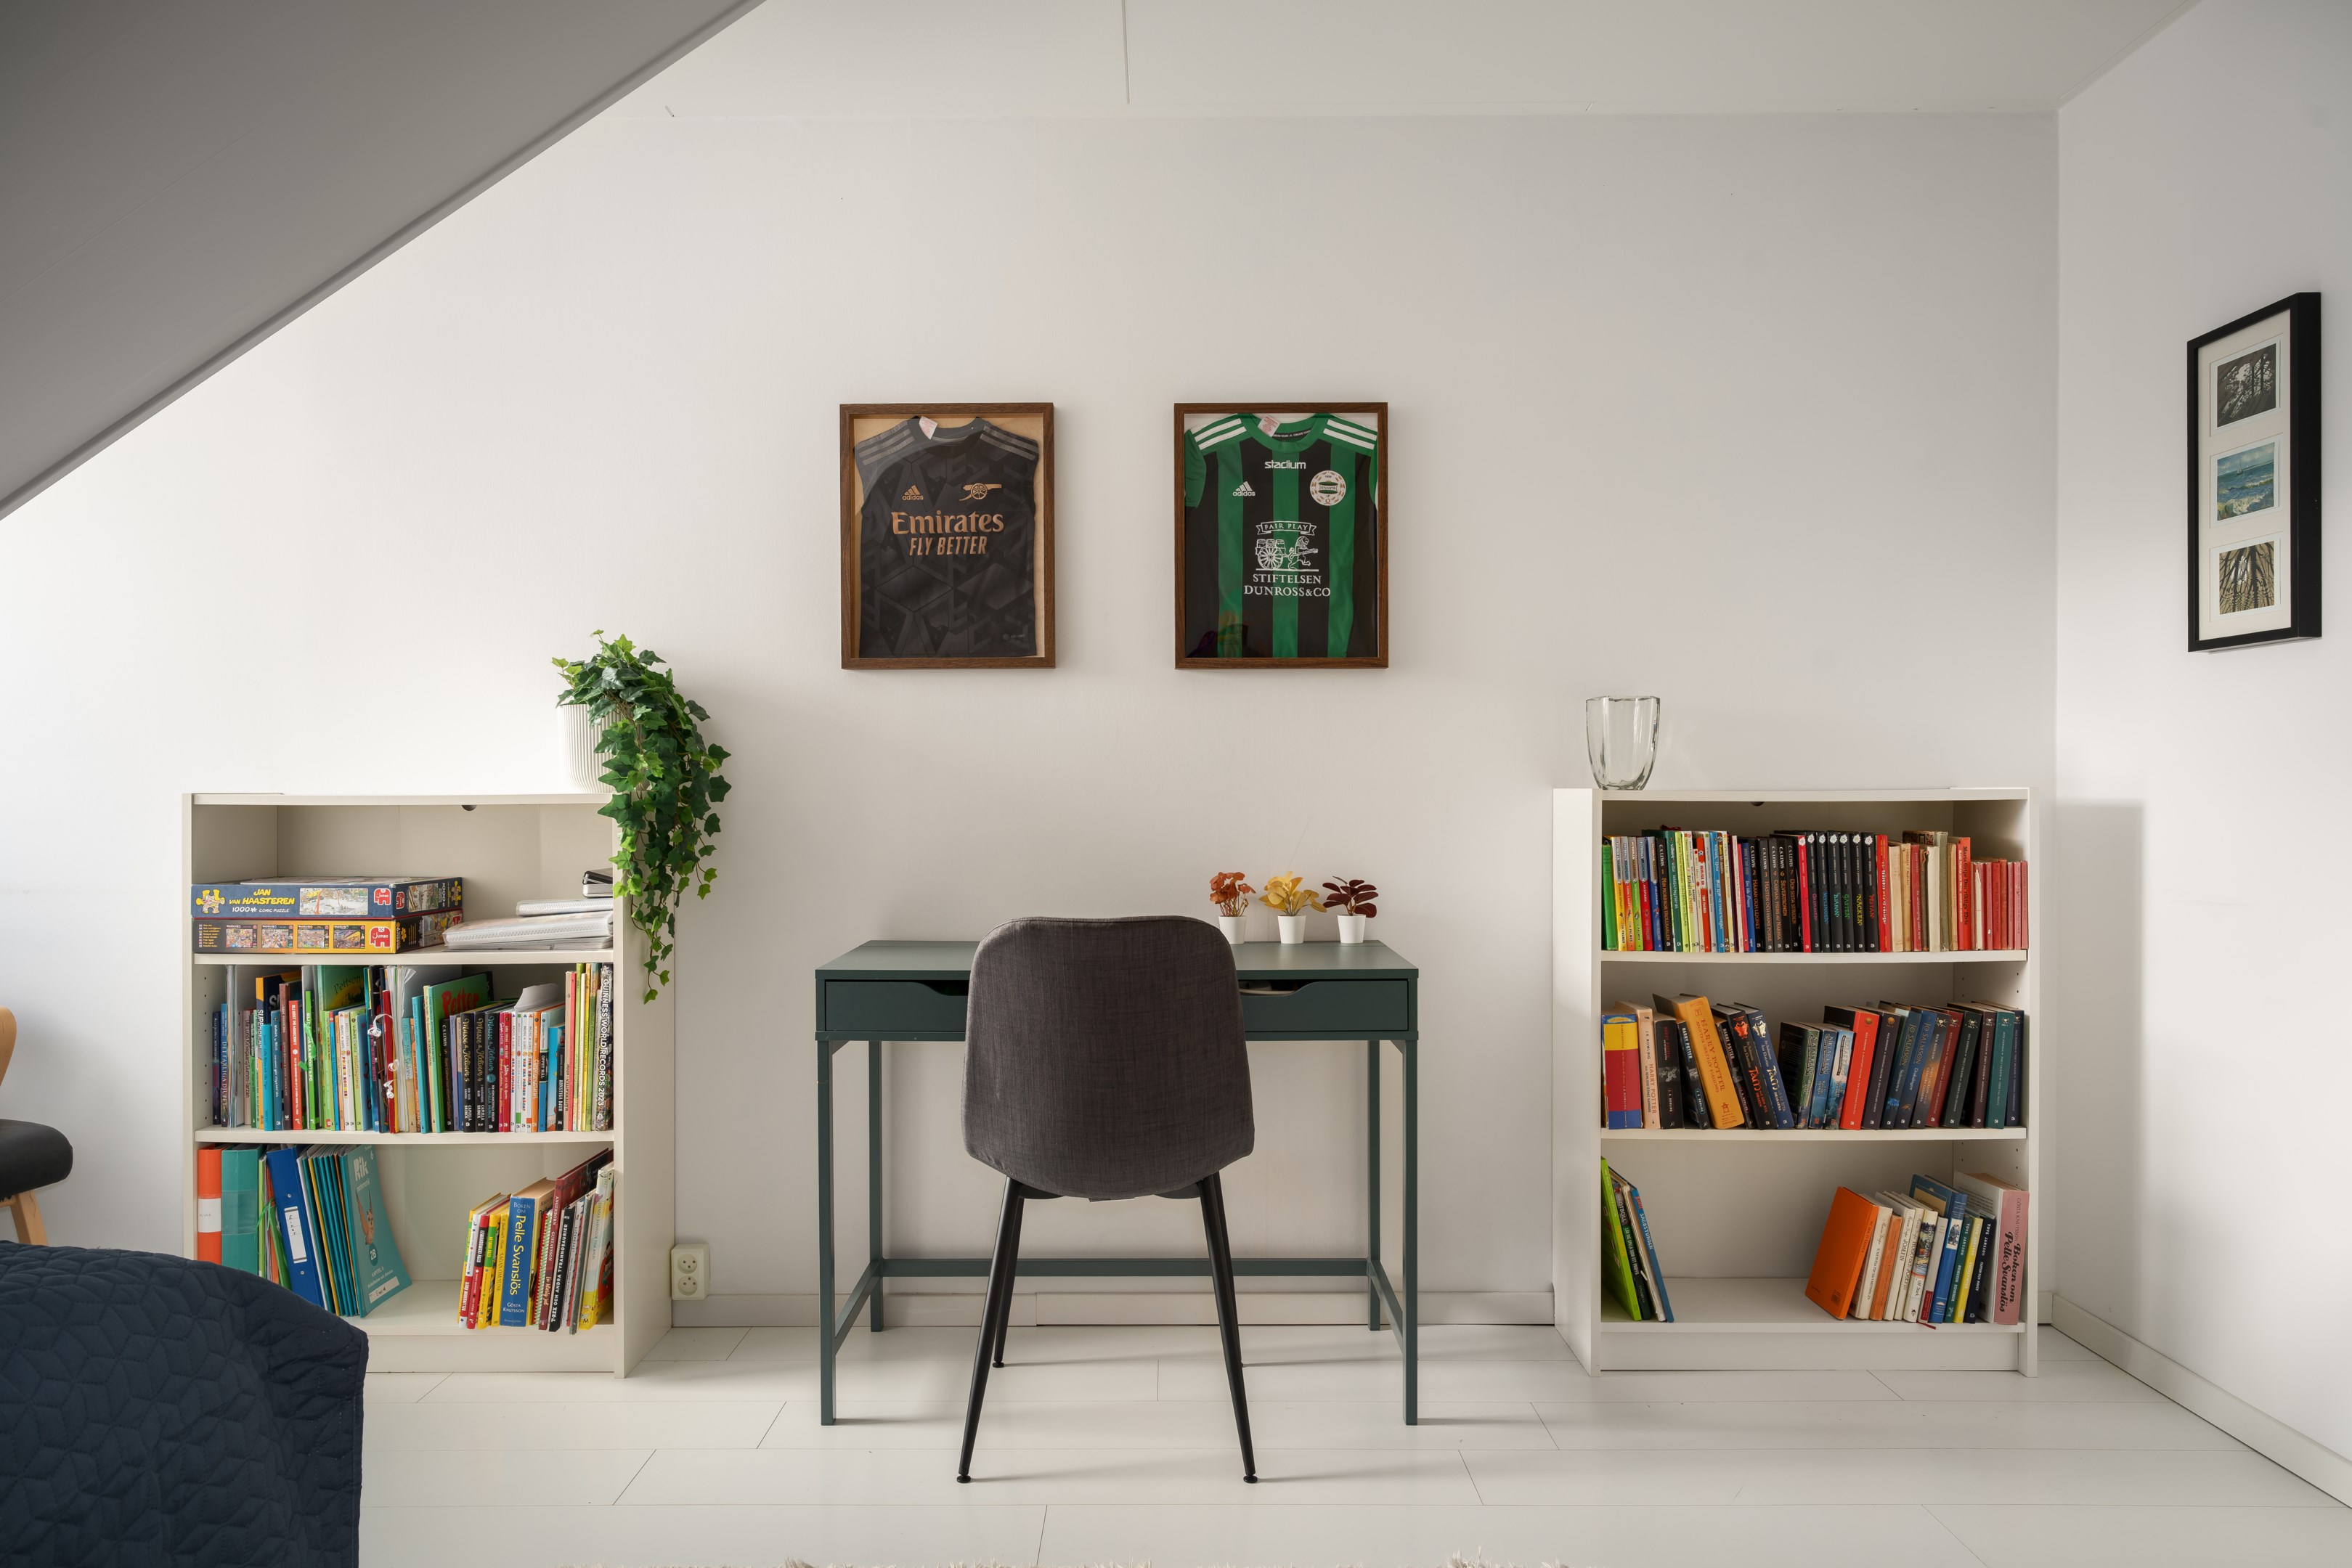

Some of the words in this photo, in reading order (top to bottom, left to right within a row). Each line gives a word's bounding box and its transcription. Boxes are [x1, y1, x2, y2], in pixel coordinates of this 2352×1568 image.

[1265, 460, 1306, 470] stadium
[892, 510, 1004, 535] Emirates
[910, 536, 932, 556] FLY
[937, 536, 988, 555] BETTER
[1244, 585, 1330, 597] DUNROSS&CO
[1253, 574, 1322, 584] STIFTELSEN
[333, 975, 362, 994] Pettson
[441, 987, 479, 1018] Petter
[1909, 1024, 1916, 1033] JO
[1924, 1022, 1932, 1032] JO
[1701, 1019, 1715, 1053] HARRY
[1712, 1057, 1725, 1091] POTTER
[1901, 1034, 1915, 1066] SALMSON
[1916, 1033, 1929, 1064] SALMSON
[598, 1050, 607, 1086] RECORDS
[370, 1150, 374, 1160] 6
[1617, 1199, 1627, 1222] FOTBOLL
[513, 1214, 526, 1243] Pelle
[1639, 1213, 1653, 1249] SAGOSTUNDEN
[557, 1224, 568, 1273] TYRANNOSAURIER
[2003, 1232, 2014, 1261] Pelle
[510, 1245, 524, 1296] Svanslös
[1964, 1261, 1973, 1289] TROLLVINTER
[2011, 1243, 2022, 1283] Boken
[1999, 1262, 2011, 1312] Svanslös
[2009, 1284, 2017, 1303] om
